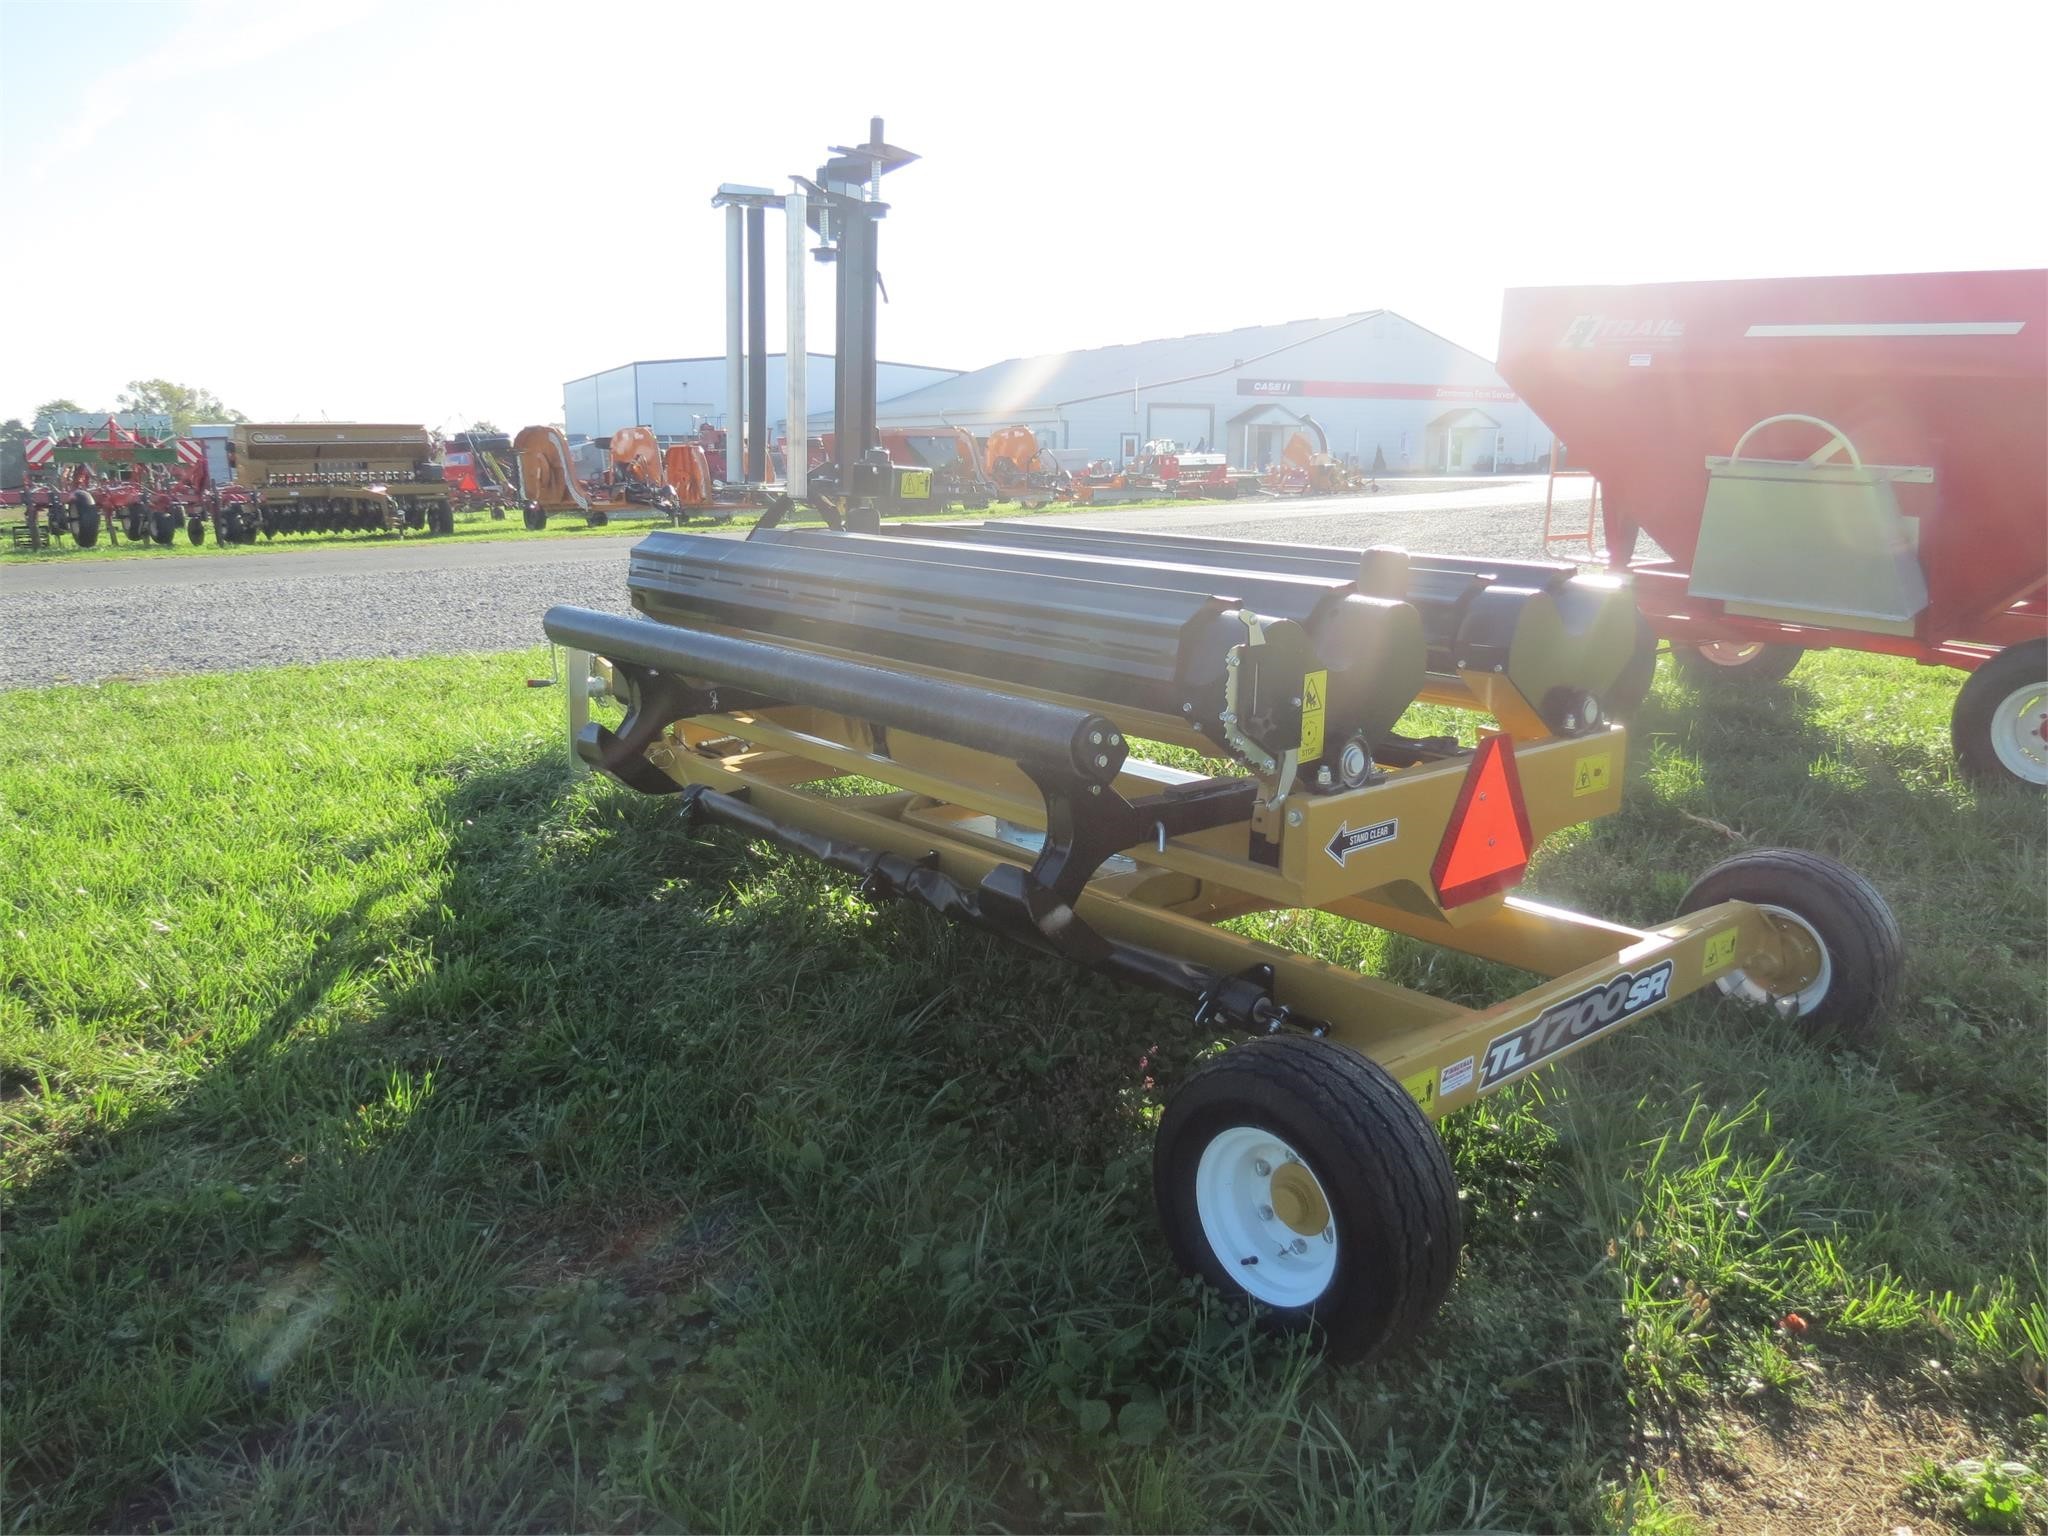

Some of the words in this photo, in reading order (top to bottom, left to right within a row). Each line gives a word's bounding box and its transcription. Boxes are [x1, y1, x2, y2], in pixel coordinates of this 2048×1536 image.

[1253, 382, 1281, 392] CASE
[1349, 831, 1369, 846] STAND
[1369, 826, 1389, 840] CLEAR
